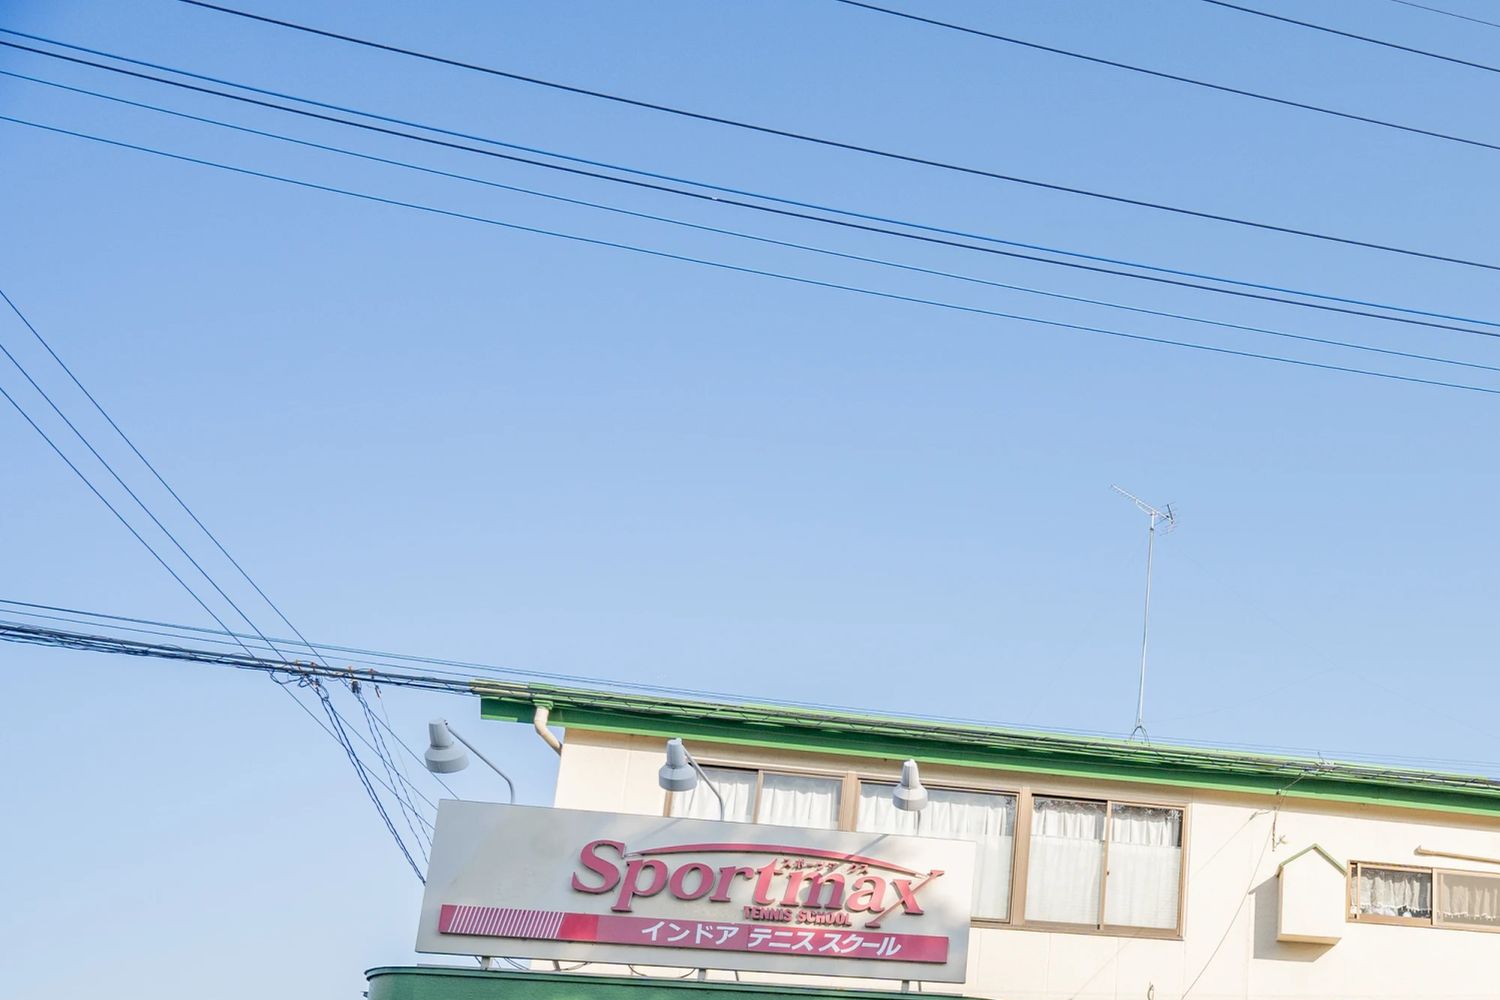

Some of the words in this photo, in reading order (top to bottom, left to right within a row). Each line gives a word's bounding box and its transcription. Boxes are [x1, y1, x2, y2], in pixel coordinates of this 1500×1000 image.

[571, 839, 944, 928] Sportmax
[743, 906, 792, 922] TENNIS
[798, 909, 853, 926] SCHOOL
